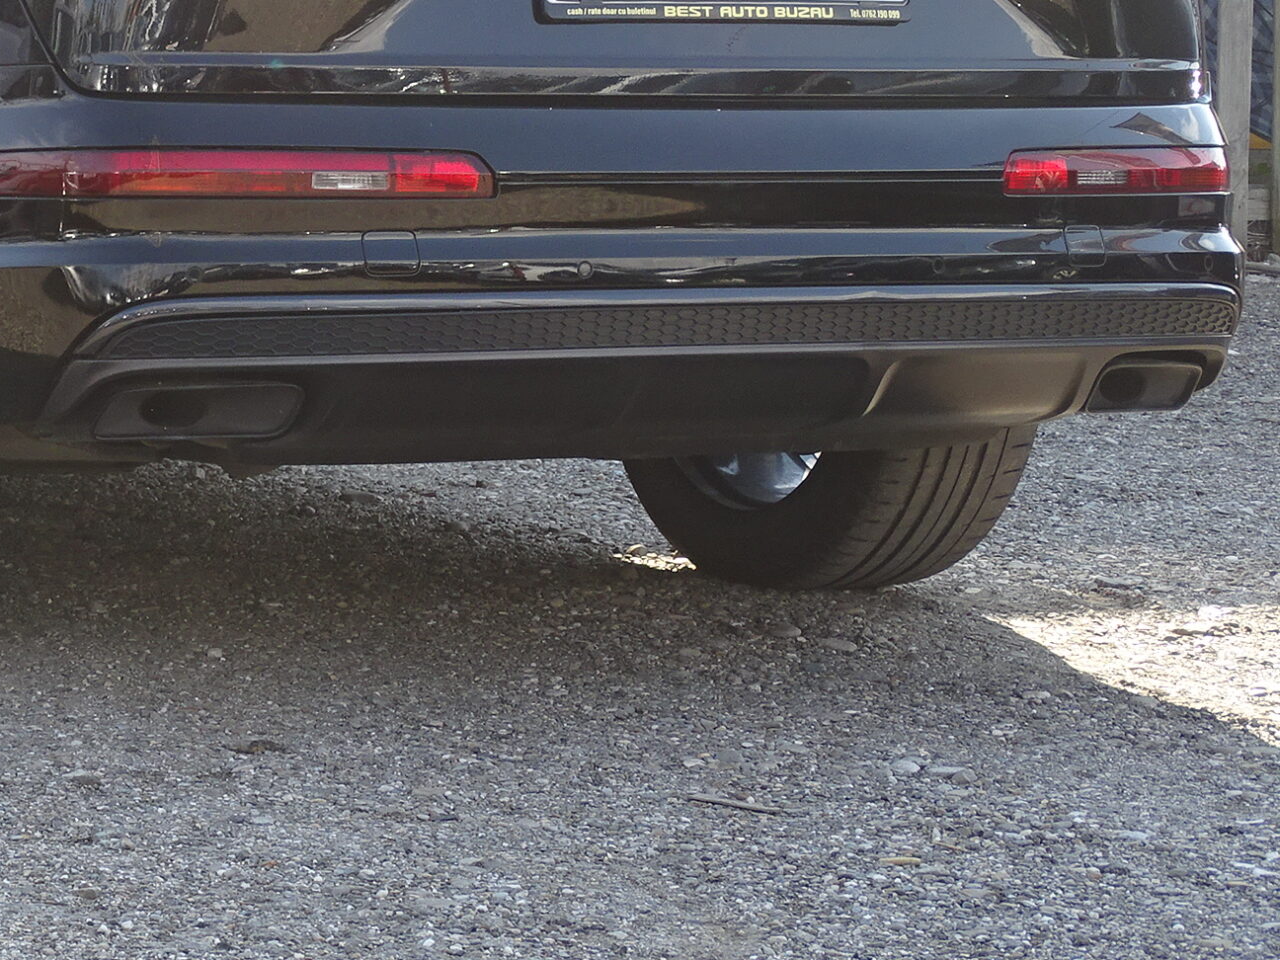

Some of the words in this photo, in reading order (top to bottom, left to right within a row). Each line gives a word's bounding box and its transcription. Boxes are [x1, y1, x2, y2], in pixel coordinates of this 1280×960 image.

[663, 6, 714, 18] BEST
[720, 6, 768, 18] AUTO
[774, 6, 835, 19] BUZAU
